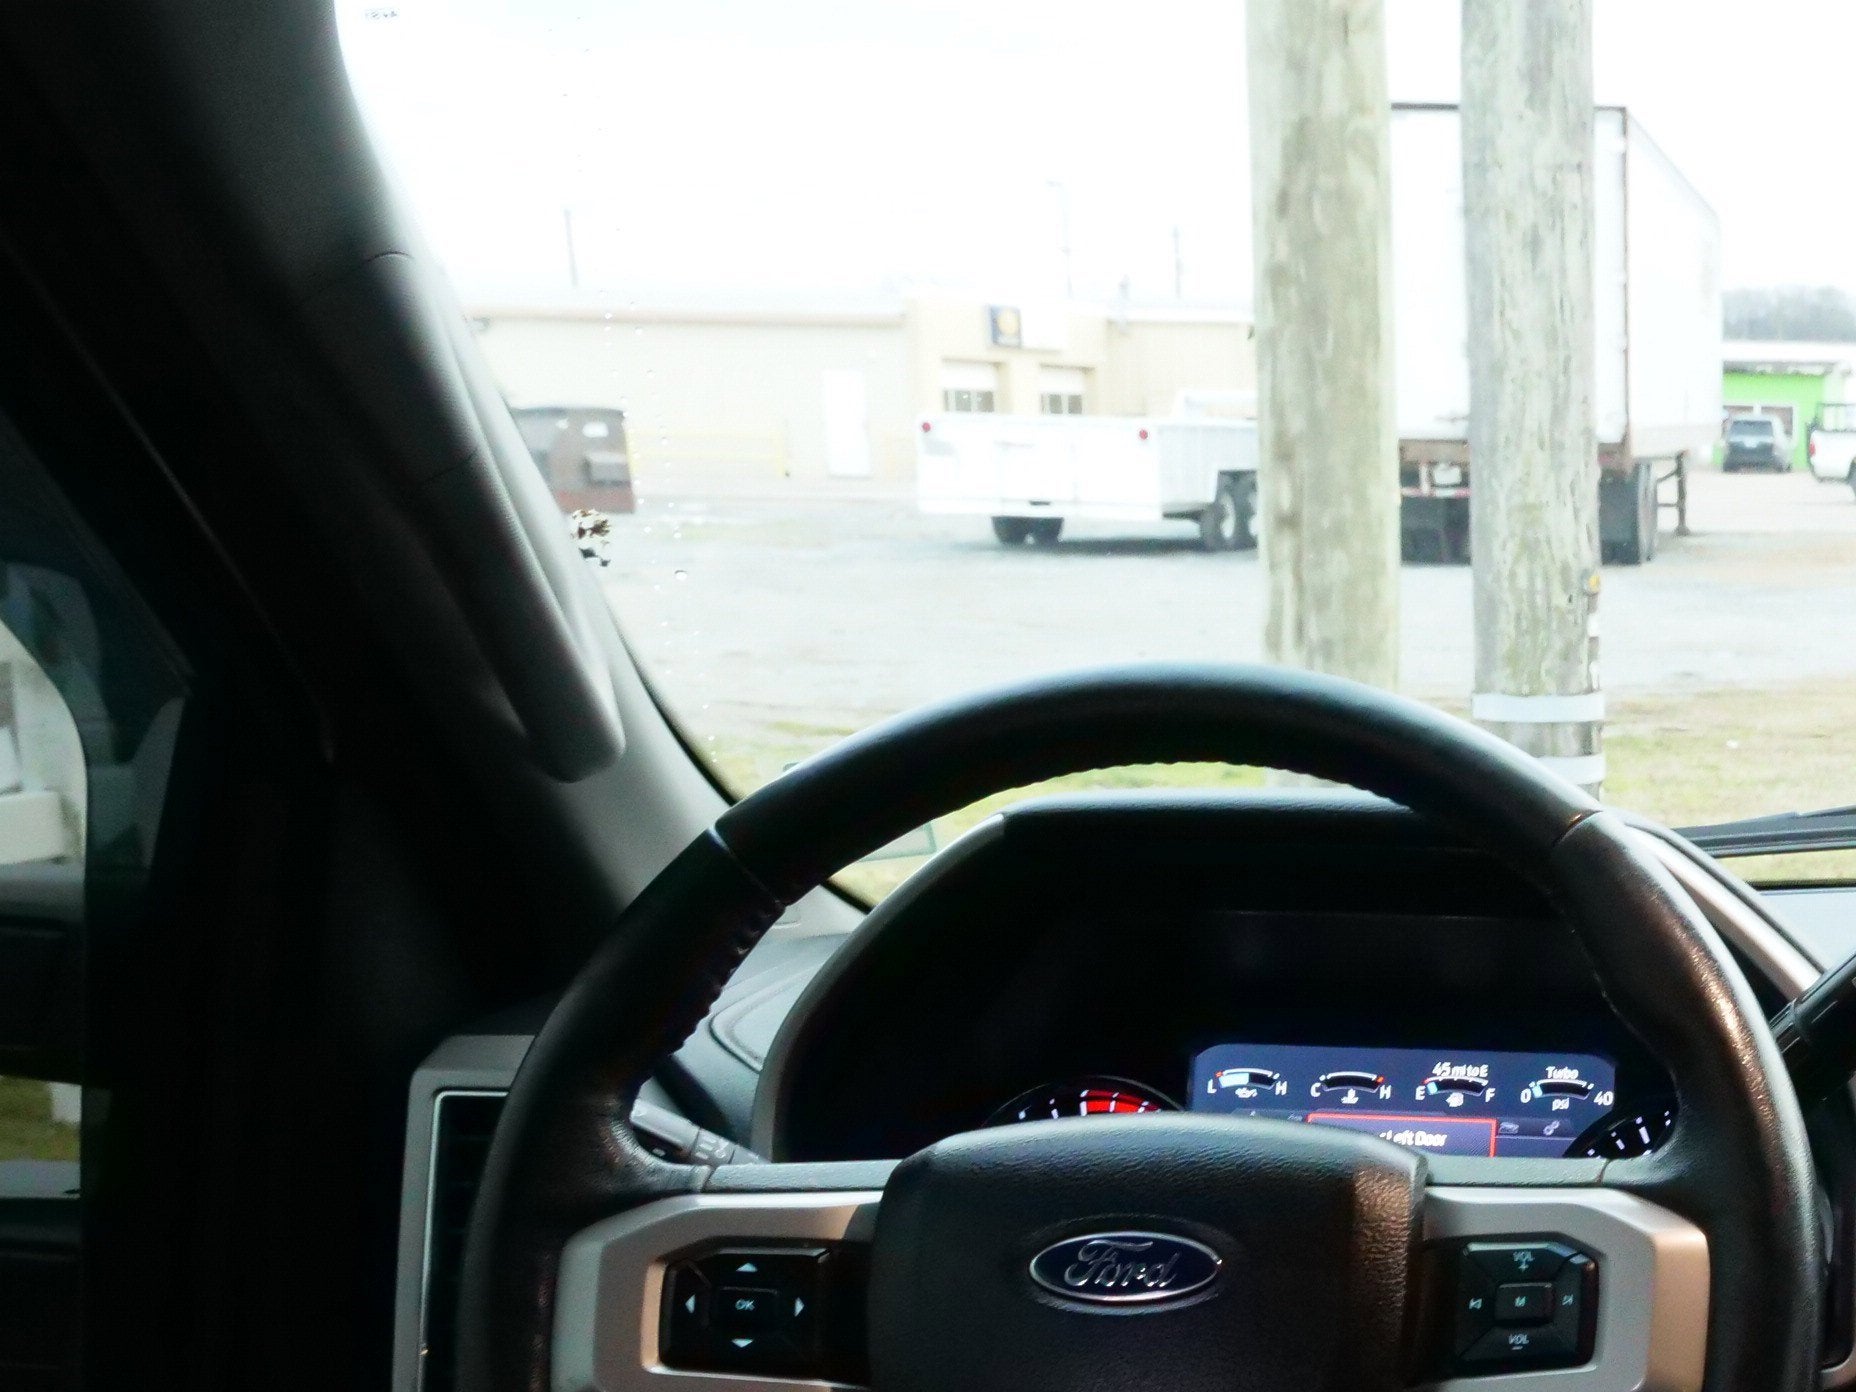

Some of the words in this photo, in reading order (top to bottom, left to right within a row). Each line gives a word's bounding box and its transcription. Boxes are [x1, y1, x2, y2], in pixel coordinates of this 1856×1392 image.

[1546, 1066, 1579, 1079] Turbo
[1275, 1081, 1288, 1096] H
[1310, 1082, 1321, 1097] C
[1379, 1085, 1391, 1100] H
[1415, 1085, 1426, 1101] E
[1485, 1088, 1496, 1103] F
[1593, 1090, 1614, 1105] 40
[1415, 1130, 1447, 1147] Door
[1064, 1239, 1181, 1287] Ford
[734, 1299, 757, 1311] OK
